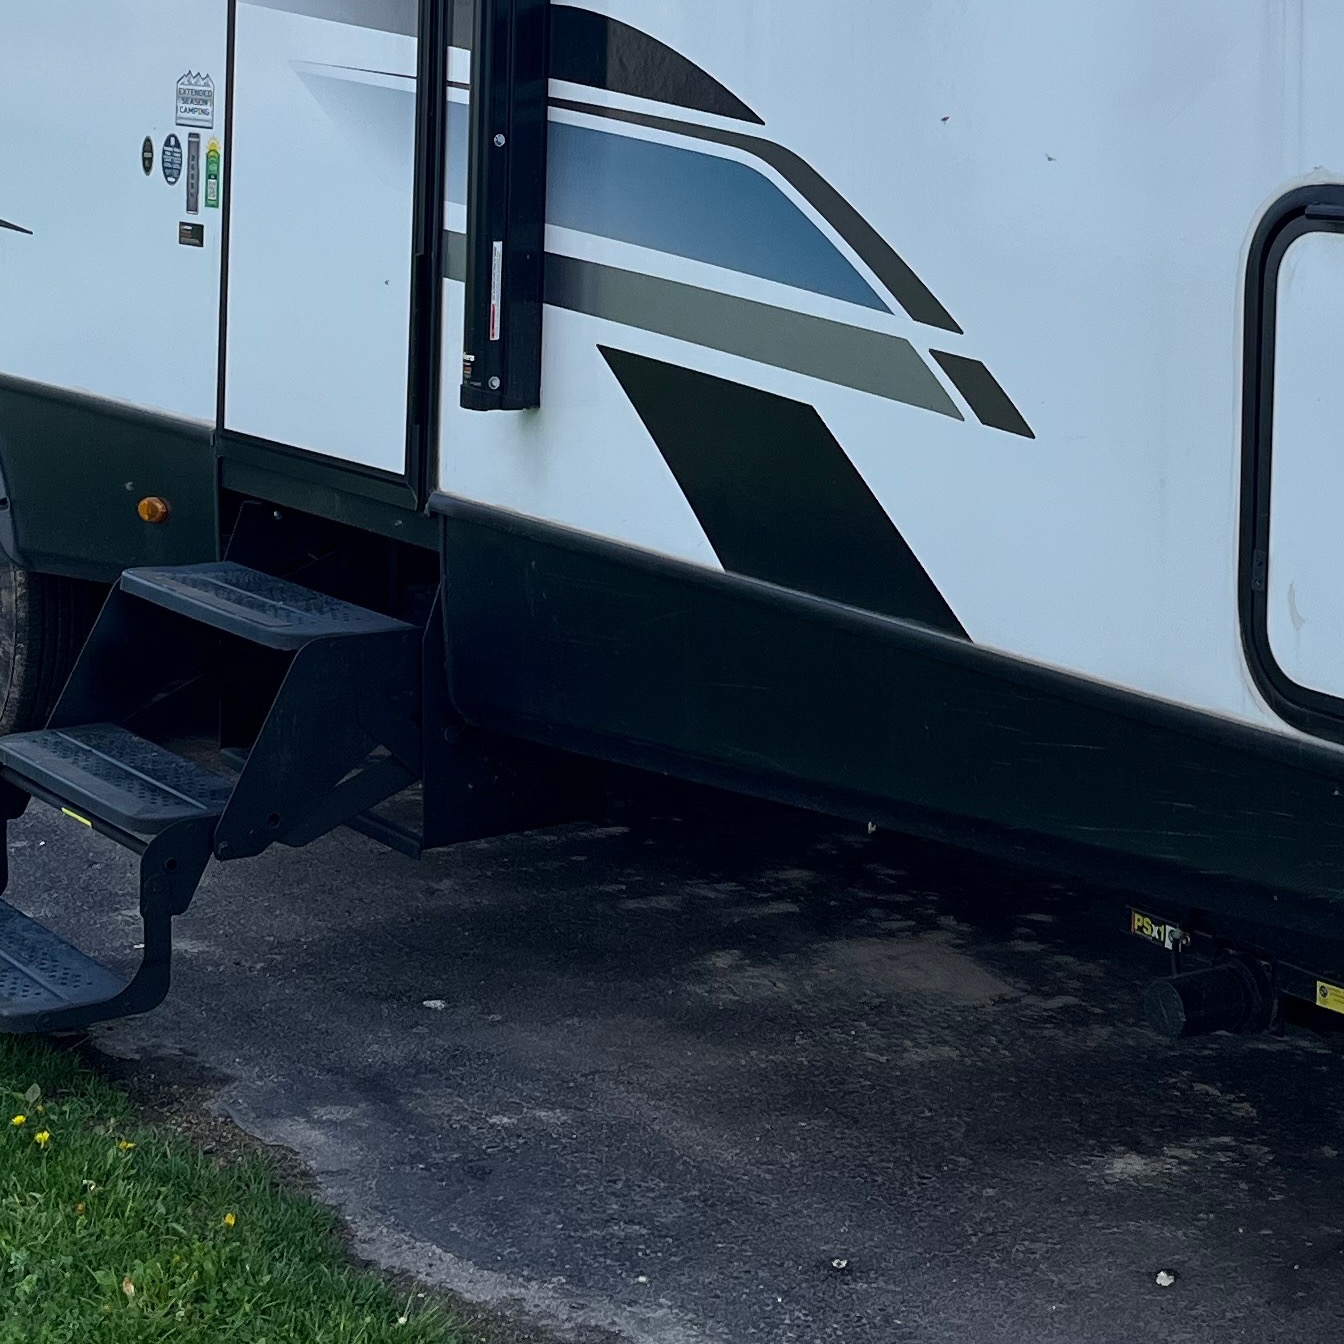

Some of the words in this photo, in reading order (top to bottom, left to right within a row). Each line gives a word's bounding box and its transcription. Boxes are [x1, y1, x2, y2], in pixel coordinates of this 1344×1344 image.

[178, 87, 212, 97] EXTENDED
[181, 97, 209, 106] SEASON
[179, 106, 210, 116] CAMPING
